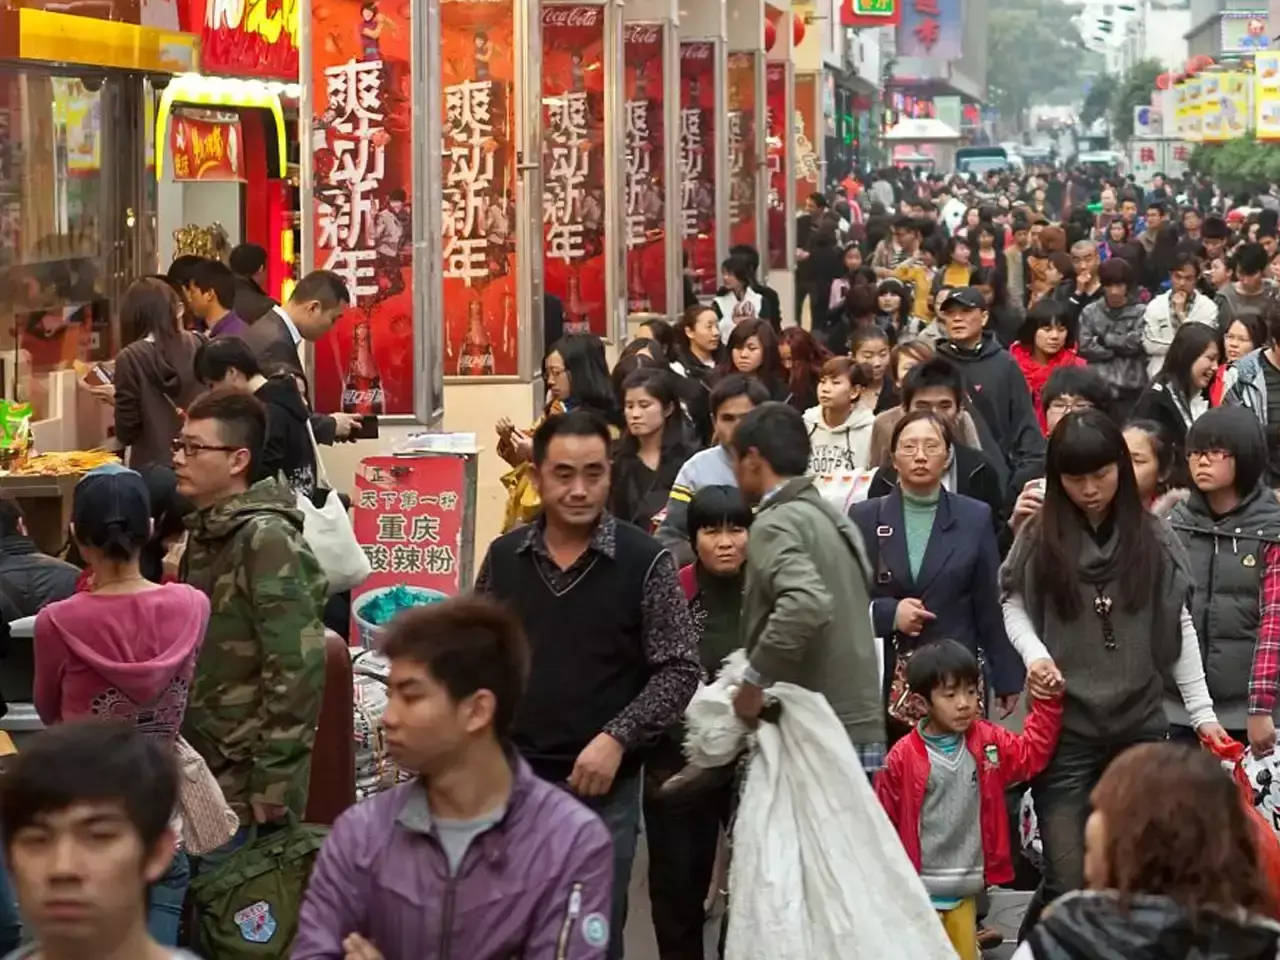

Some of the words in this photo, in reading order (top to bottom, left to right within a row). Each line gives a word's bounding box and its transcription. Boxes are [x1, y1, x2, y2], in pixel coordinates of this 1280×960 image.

[376, 513, 442, 543] 重庆
[361, 544, 454, 574] 酸辣粉
